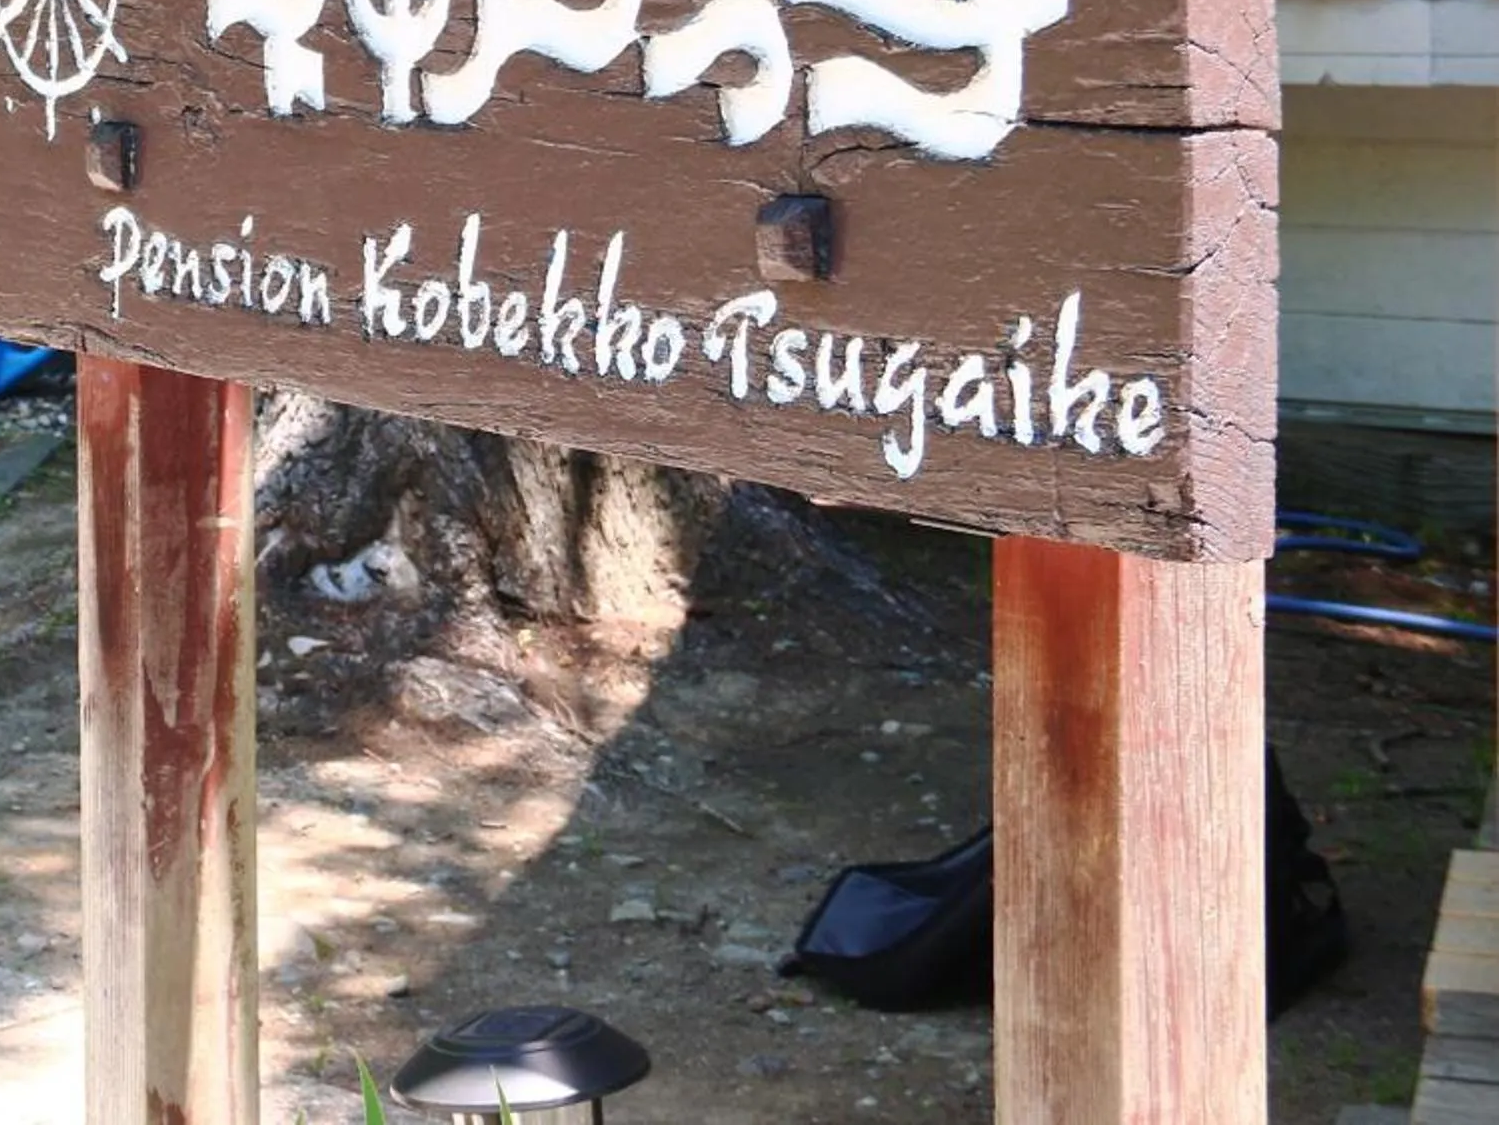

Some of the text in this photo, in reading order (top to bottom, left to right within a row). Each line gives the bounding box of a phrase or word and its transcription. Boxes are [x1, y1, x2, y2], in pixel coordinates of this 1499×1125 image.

[99, 206, 1167, 478] Pension Kobekko Tsugaike
